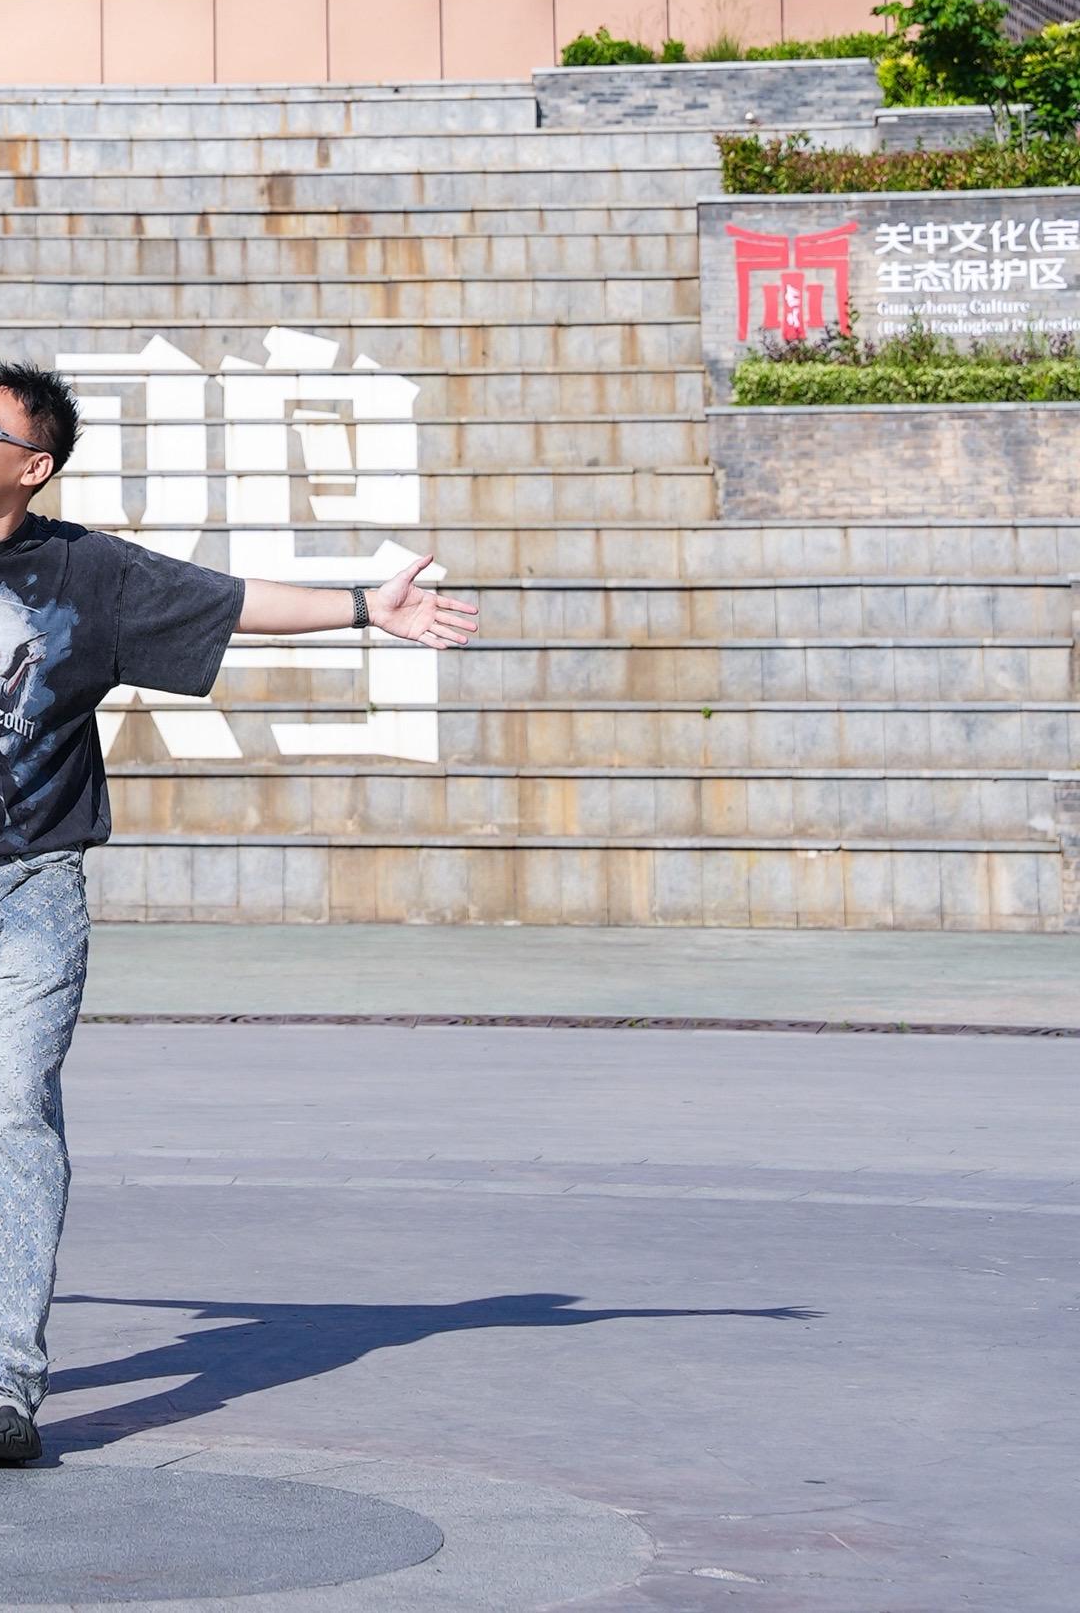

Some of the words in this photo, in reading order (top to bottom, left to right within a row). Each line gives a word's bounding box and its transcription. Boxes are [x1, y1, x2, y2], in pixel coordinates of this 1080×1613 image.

[876, 258, 1068, 293] 生态保护区
[970, 298, 1031, 314] Culture
[931, 319, 1009, 335] Ecological
